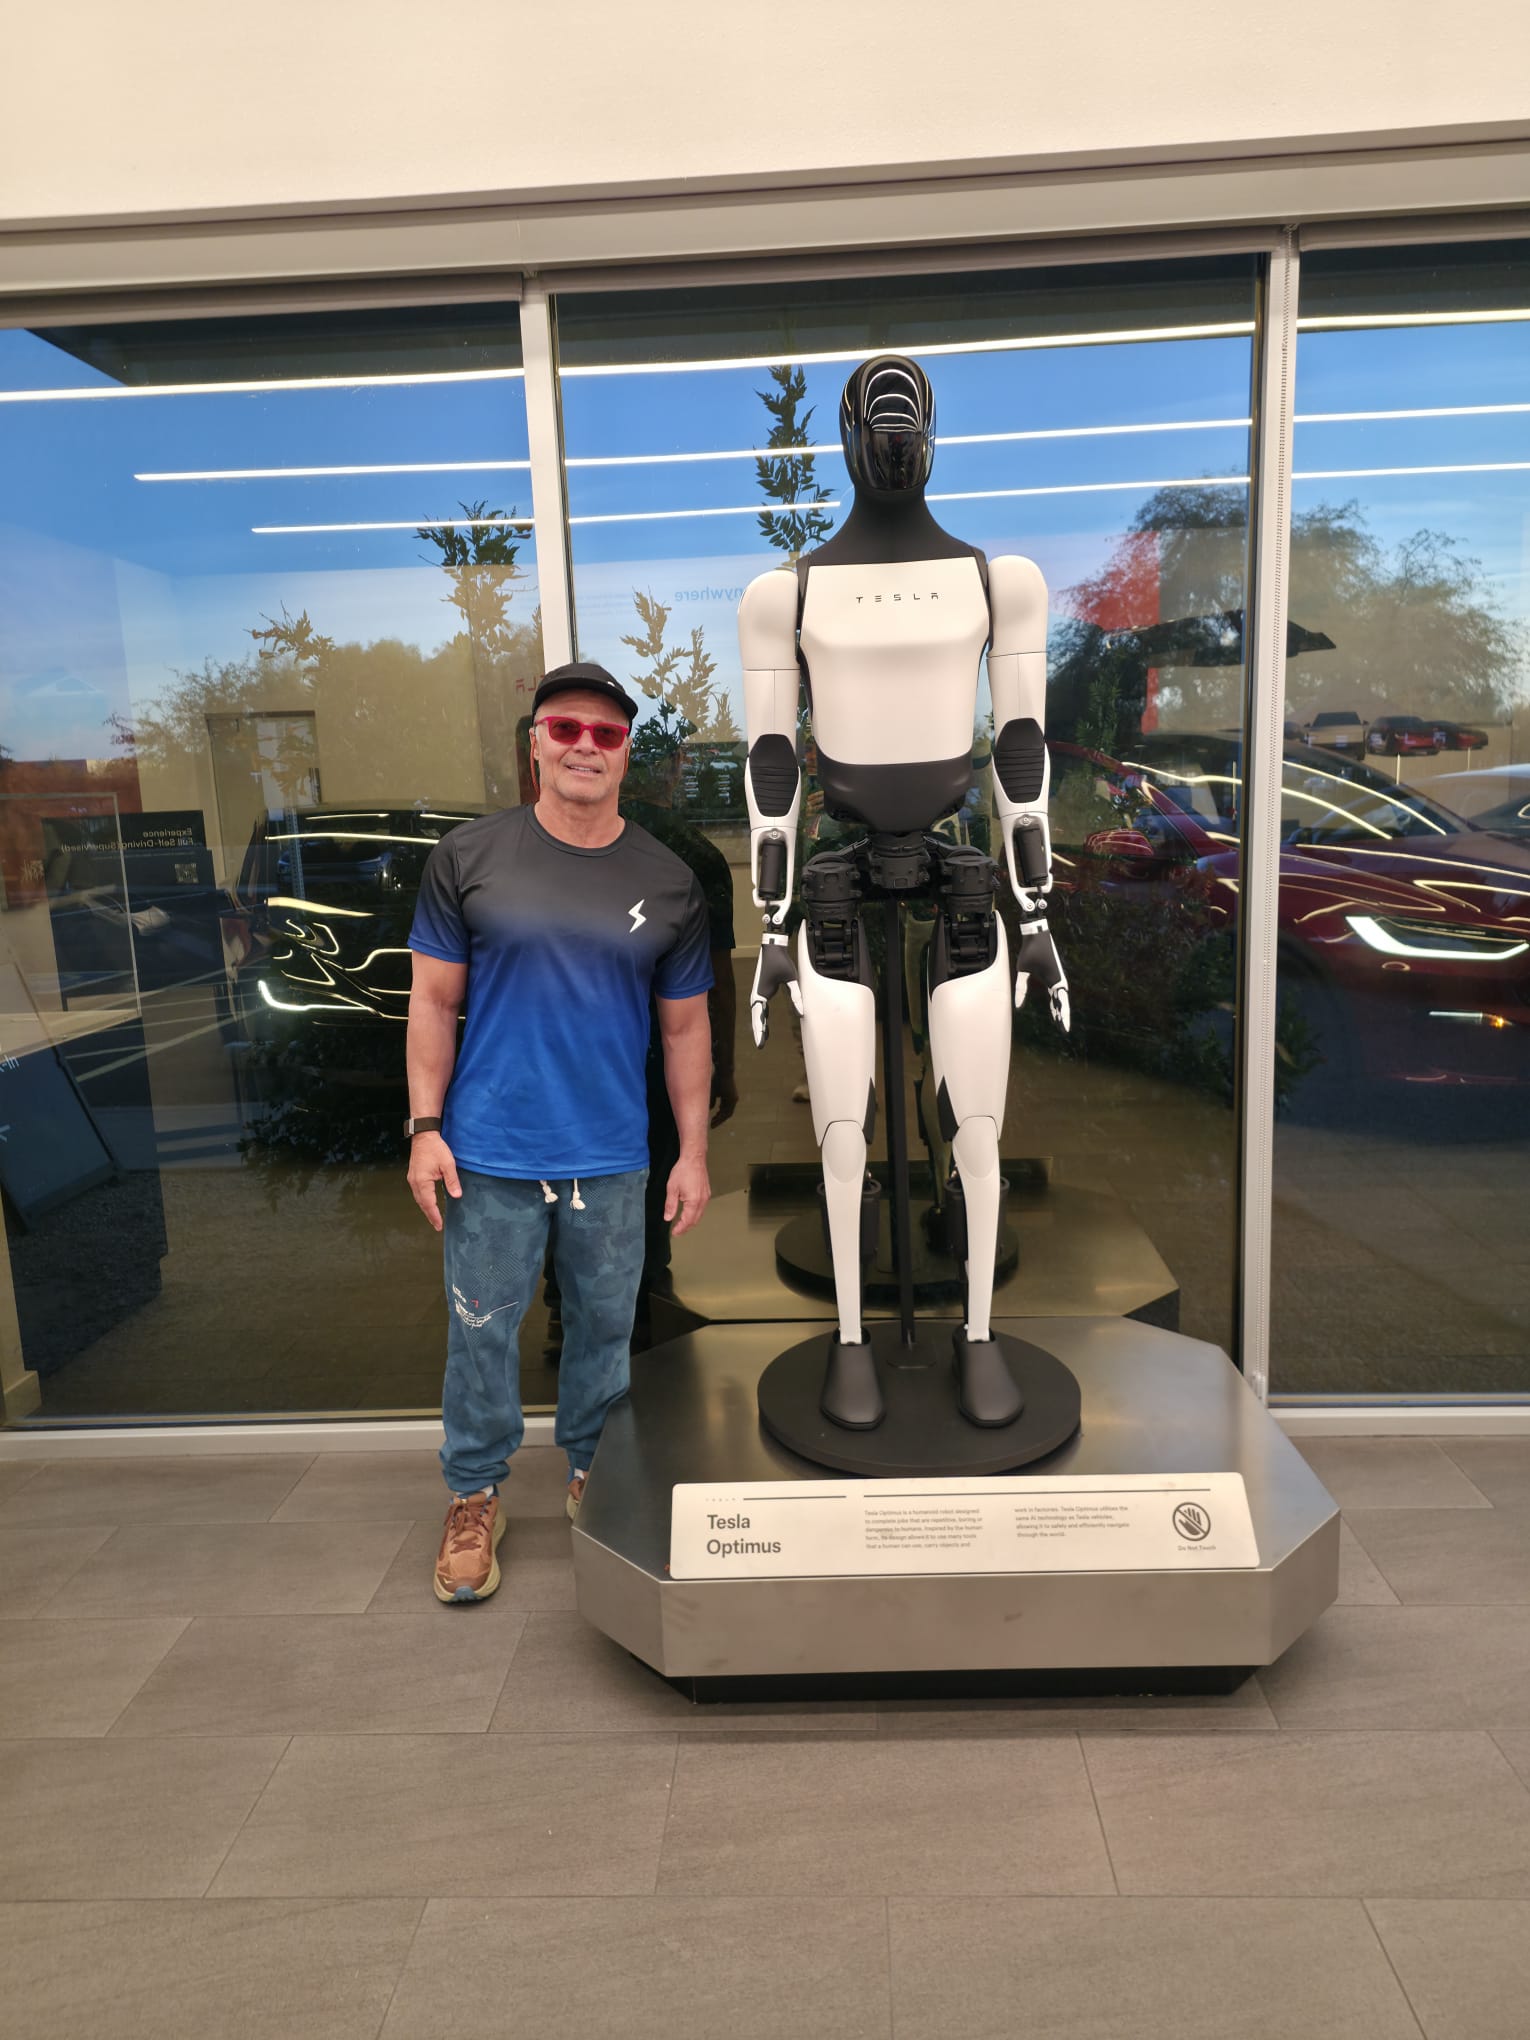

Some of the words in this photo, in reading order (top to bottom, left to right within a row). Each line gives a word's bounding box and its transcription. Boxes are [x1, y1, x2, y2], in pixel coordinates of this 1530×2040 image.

[856, 592, 939, 604] TESLA
[706, 1513, 751, 1530] Tesla
[706, 1538, 782, 1558] Optimus
